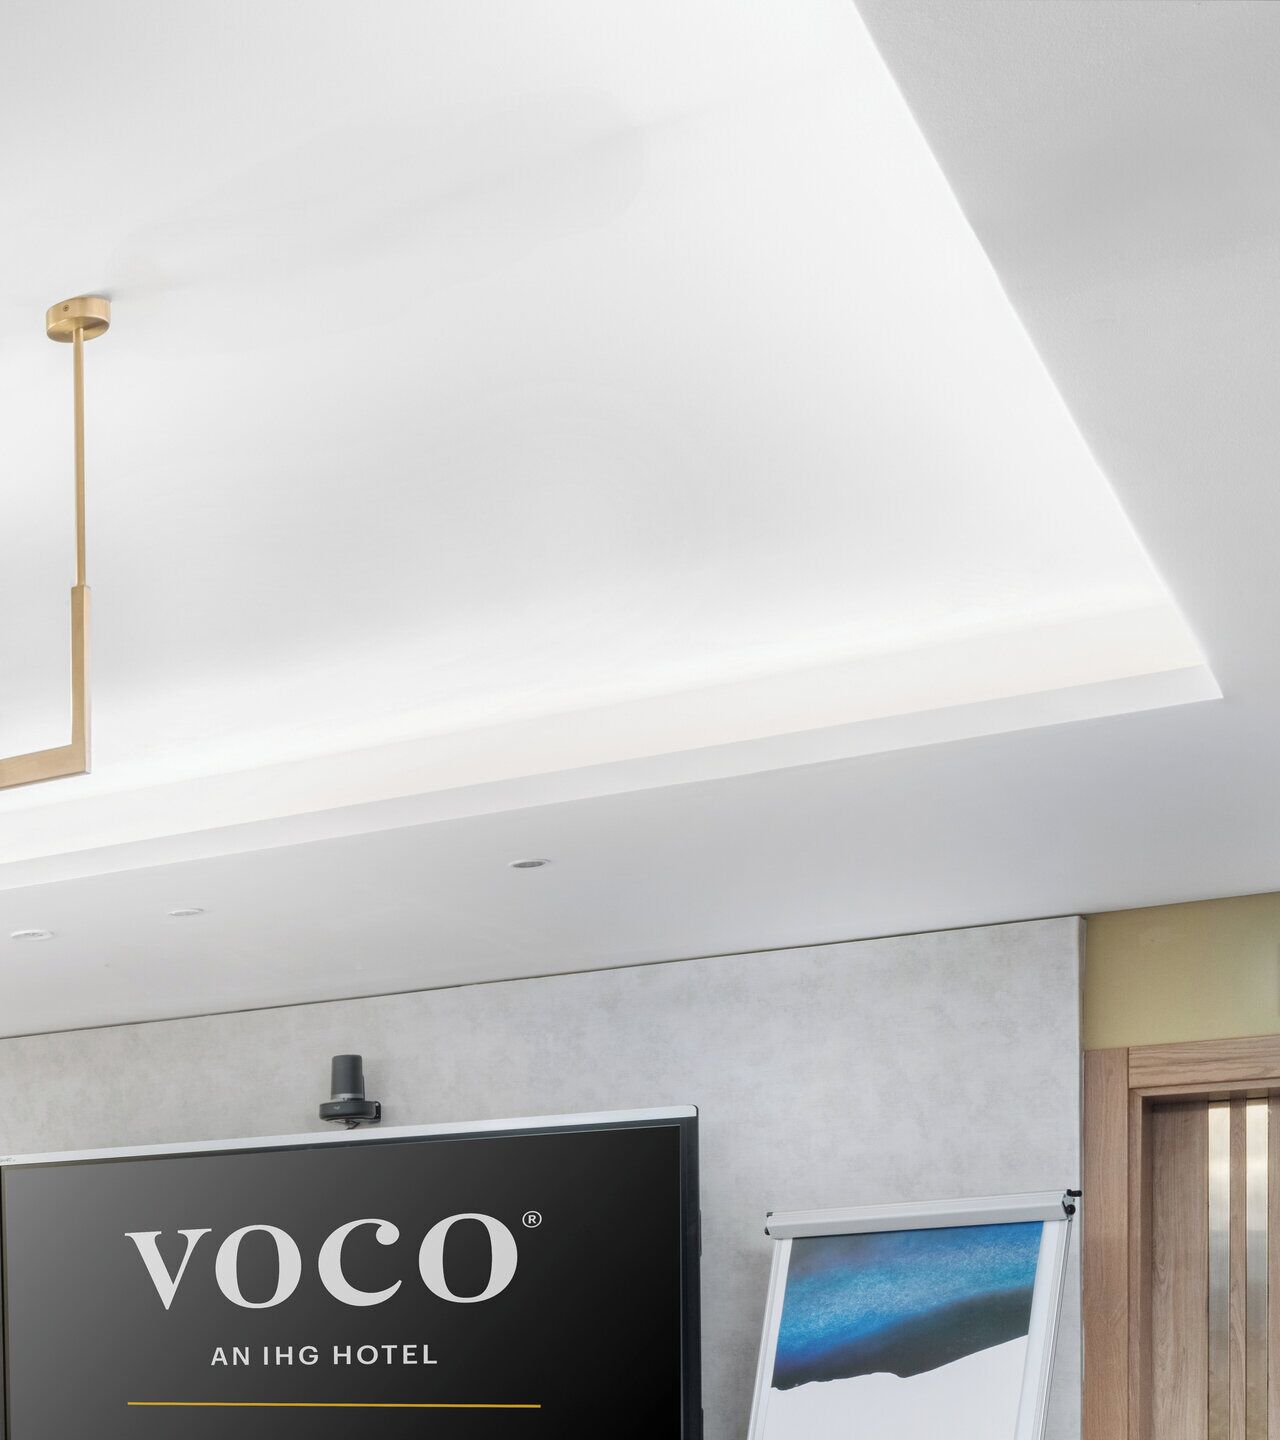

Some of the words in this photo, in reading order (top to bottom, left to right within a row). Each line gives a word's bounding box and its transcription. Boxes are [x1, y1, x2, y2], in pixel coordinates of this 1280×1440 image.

[210, 1346, 251, 1366] AN
[263, 1345, 320, 1366] IHG
[333, 1344, 438, 1365] HOTEL
